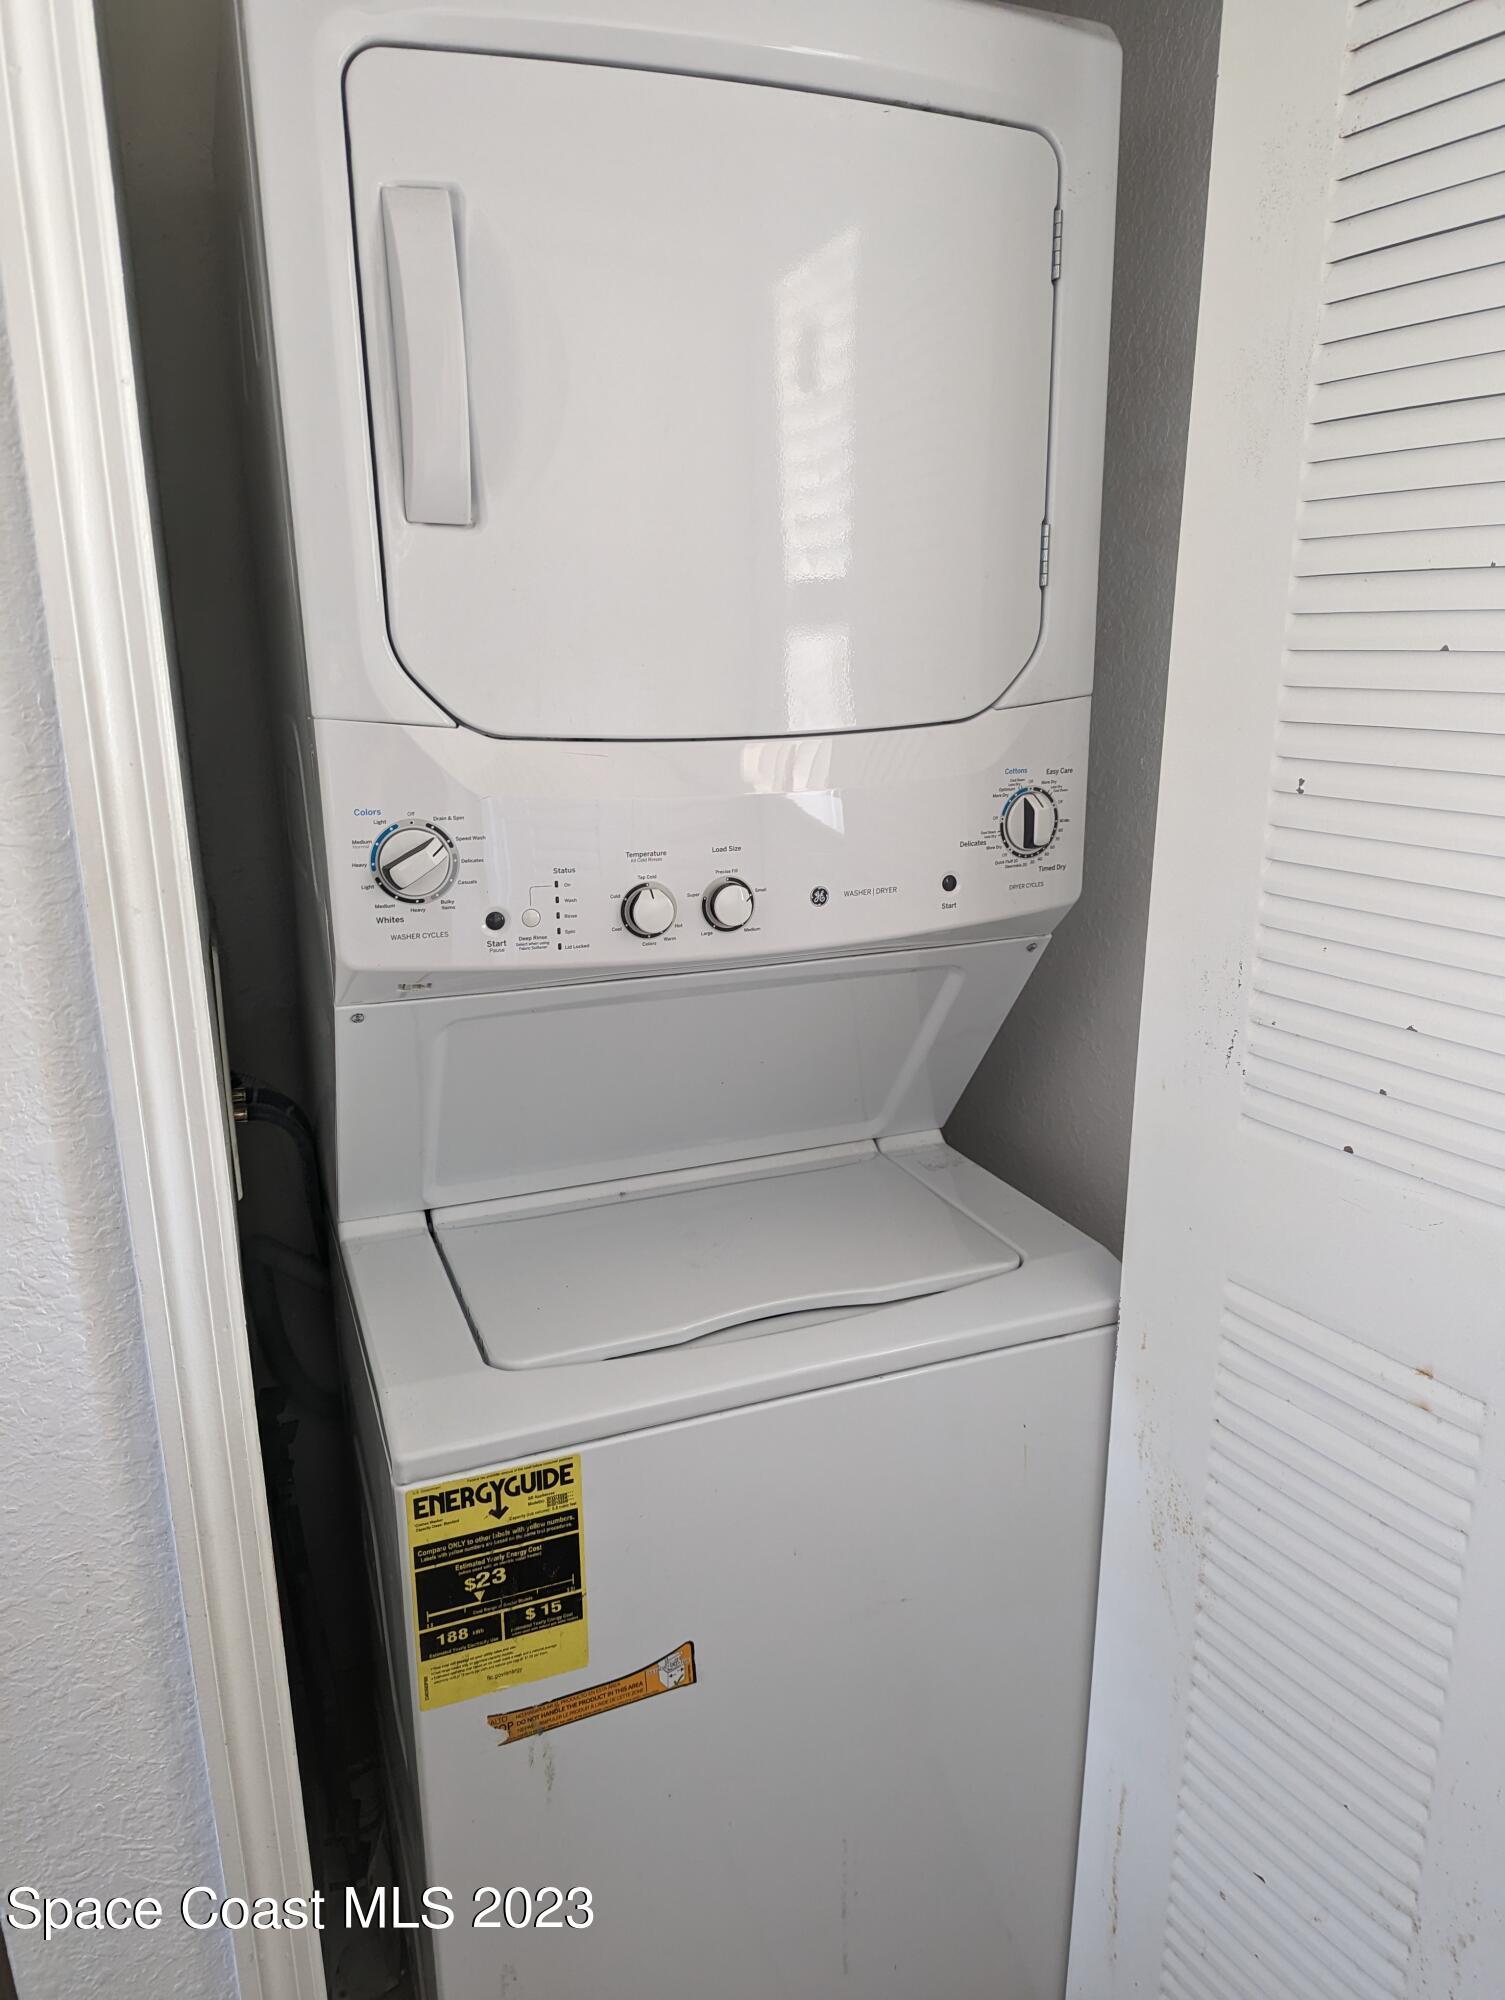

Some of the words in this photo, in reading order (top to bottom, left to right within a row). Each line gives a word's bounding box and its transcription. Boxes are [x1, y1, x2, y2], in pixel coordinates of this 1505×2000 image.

[1004, 767, 1028, 775] Cottons
[1046, 768, 1059, 776] Easy
[353, 808, 382, 817] Colors
[711, 845, 727, 853] Load
[728, 844, 742, 852] Size
[959, 840, 986, 848] Delicates
[626, 850, 667, 859] Temperature
[553, 867, 576, 875] Status
[1026, 881, 1044, 889] CYCLES
[843, 888, 871, 897] WASHER
[876, 886, 898, 895] DRYER
[941, 902, 957, 910] Start
[376, 916, 405, 925] Whites
[390, 933, 421, 941] WASHER
[422, 931, 449, 940] CYCLES
[486, 940, 507, 948] Start
[413, 1463, 574, 1520] ENERGYGUIDE
[417, 1545, 447, 1557] Compare
[448, 1539, 466, 1550] ONLY
[475, 1535, 491, 1544] other
[512, 1526, 525, 1534] with
[547, 1515, 576, 1526] numbers.
[455, 1558, 486, 1571] Estimated
[506, 1548, 527, 1559] Energy
[528, 1544, 542, 1553] Cost
[464, 1567, 507, 1592] $23
[525, 1607, 536, 1621] $
[540, 1601, 562, 1616] 15
[436, 1627, 469, 1646] 188
[516, 1719, 526, 1727] DO
[527, 1715, 540, 1723] NOT
[541, 1708, 565, 1718] HANDLE
[566, 1702, 578, 1710] THE
[578, 1693, 606, 1706] PRODUCT
[614, 1686, 628, 1695] THIS
[628, 1681, 644, 1690] AREA
